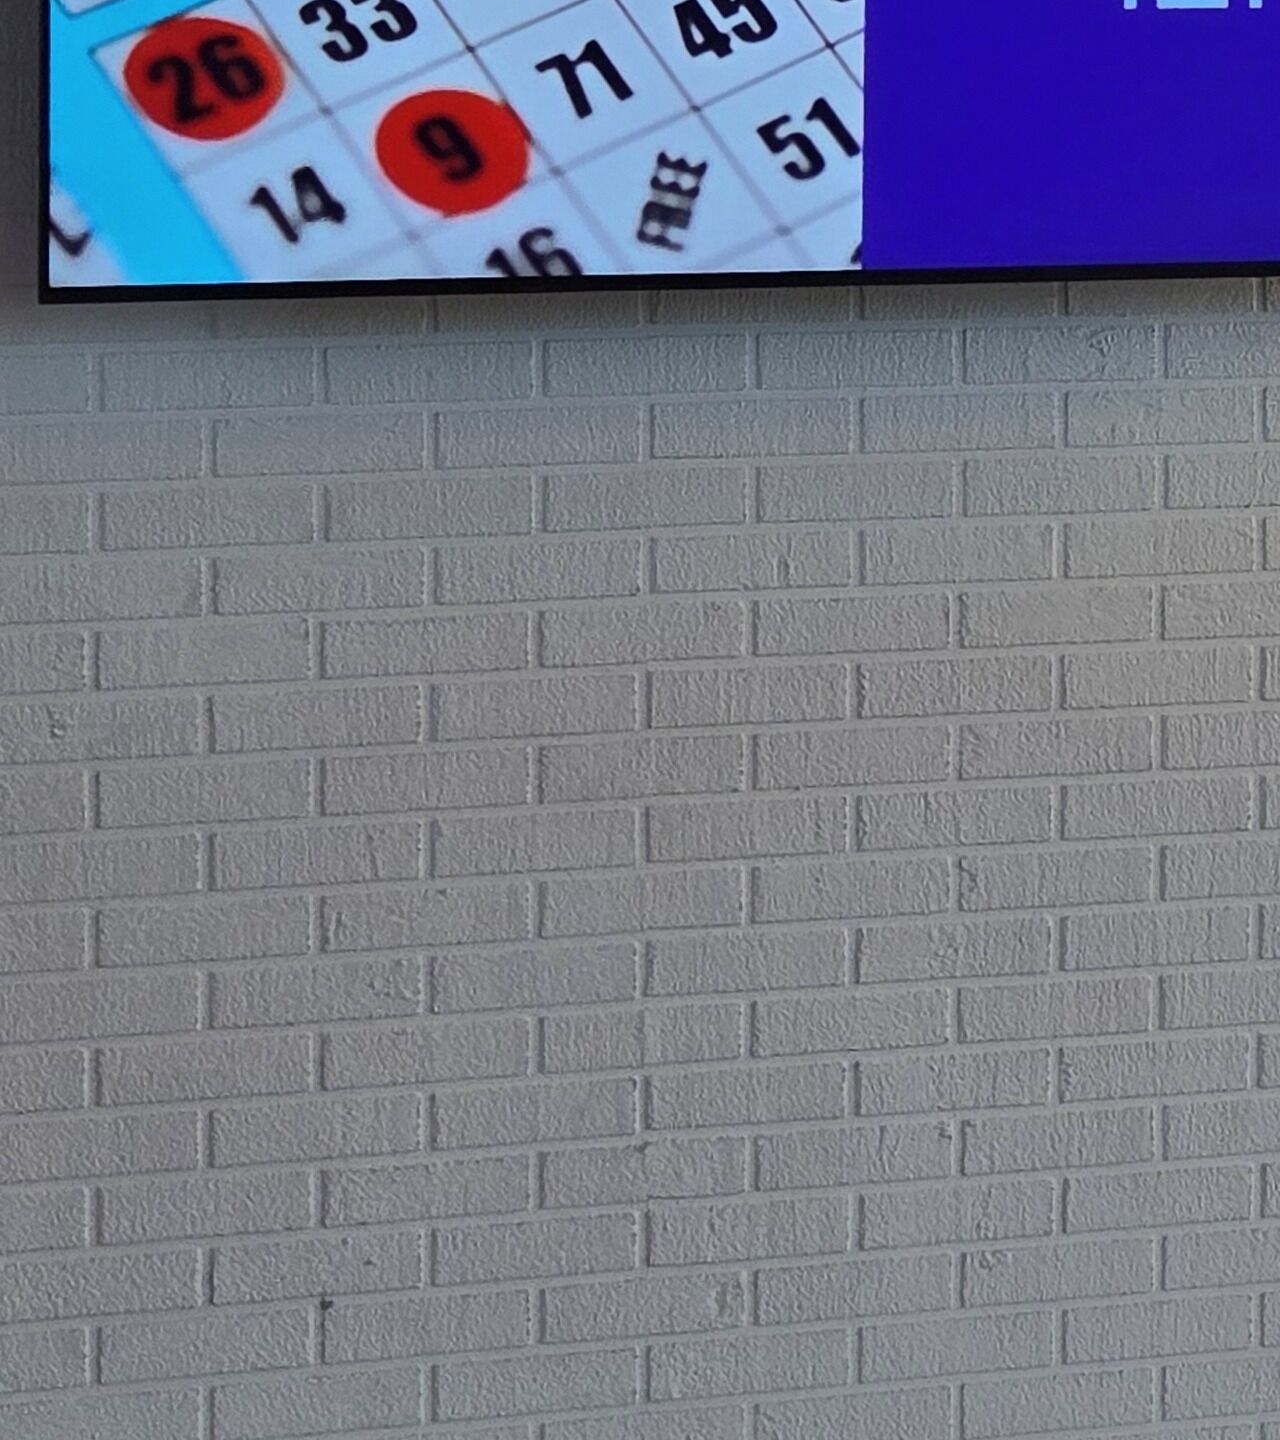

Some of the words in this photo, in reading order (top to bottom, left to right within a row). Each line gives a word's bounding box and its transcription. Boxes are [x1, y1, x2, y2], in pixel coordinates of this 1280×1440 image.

[147, 34, 265, 125] 26
[249, 165, 346, 244] 14
[413, 114, 484, 183] 9
[534, 38, 635, 120] 71
[755, 96, 861, 181] 51
